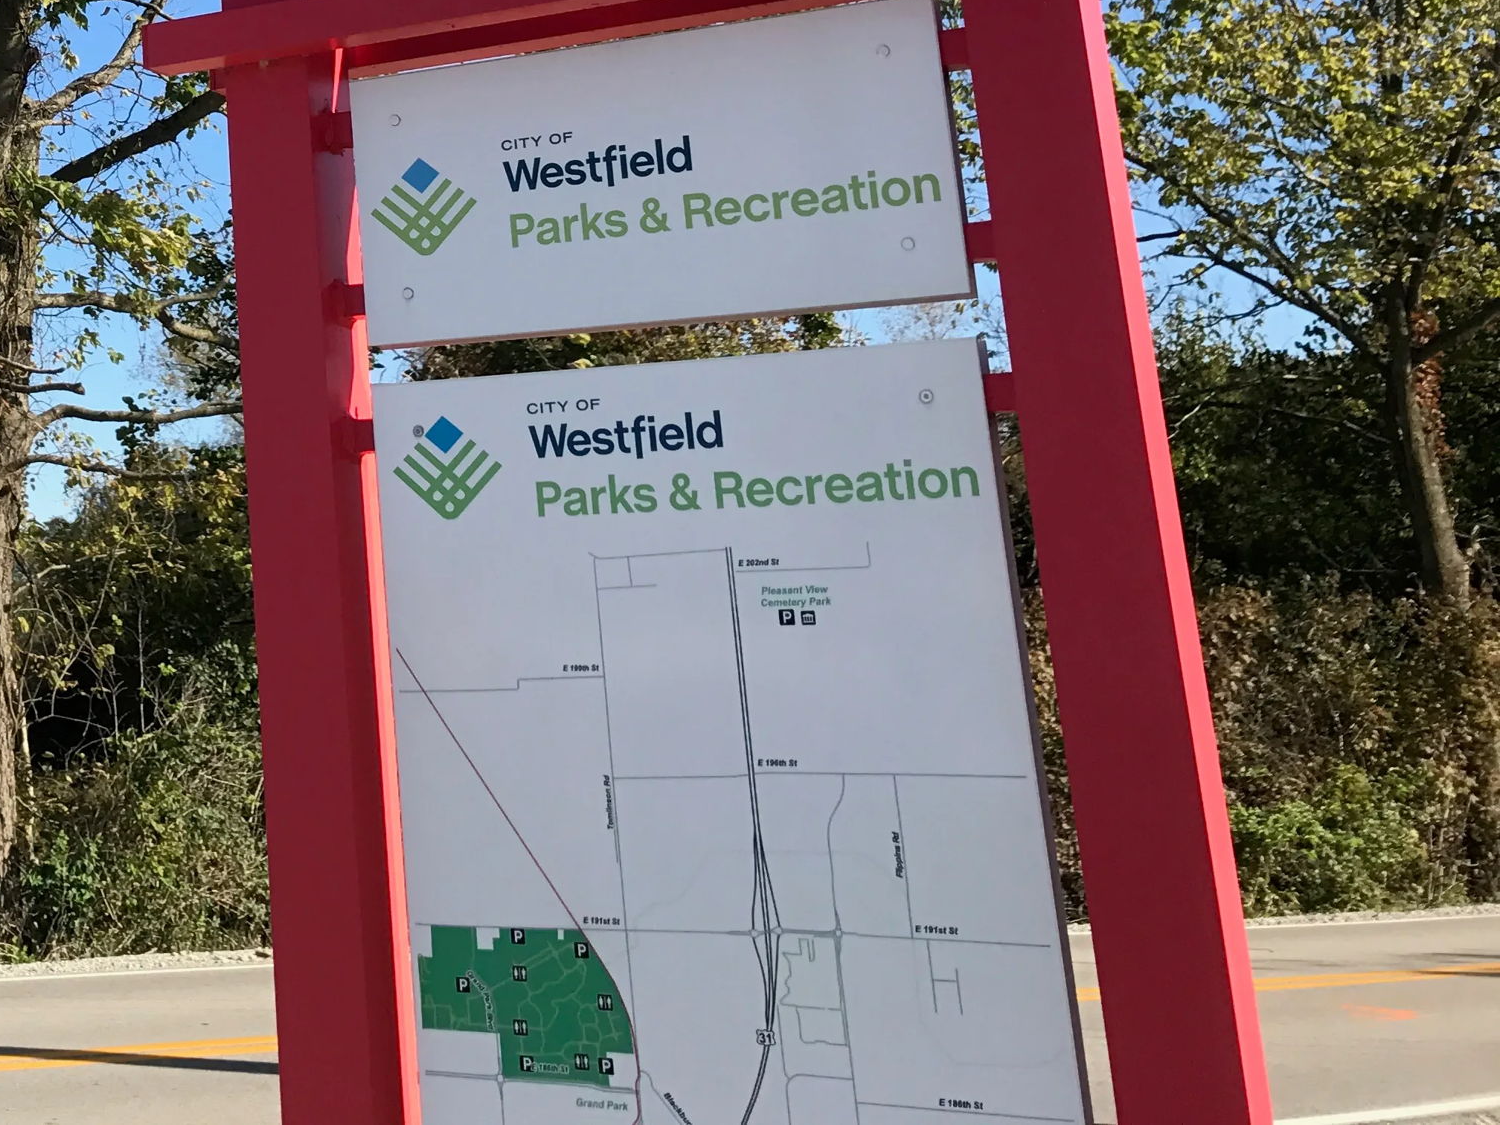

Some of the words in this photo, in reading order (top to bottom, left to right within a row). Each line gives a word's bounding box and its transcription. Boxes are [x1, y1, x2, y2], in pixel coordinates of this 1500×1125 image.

[500, 136, 542, 151] CITY
[549, 132, 573, 145] OF
[502, 135, 693, 192] Westfield
[509, 202, 629, 248] Parks
[639, 197, 671, 234] &
[682, 171, 942, 230] Recreation
[526, 401, 568, 415] CITY
[575, 398, 601, 411] OF
[528, 410, 724, 459] Westfield
[535, 474, 658, 517] Parks
[669, 472, 702, 511] &
[713, 459, 981, 509] Recreation
[738, 559, 744, 567] E
[746, 558, 769, 567] 202nd
[770, 558, 780, 566] St
[761, 586, 803, 596] Pleasant
[804, 585, 829, 594] View
[760, 598, 807, 609] Cemetery
[808, 597, 831, 606] Park
[562, 664, 569, 672] E
[591, 663, 600, 672] St
[757, 758, 764, 767] E
[788, 758, 798, 767] St
[602, 774, 611, 786] Rd
[582, 916, 589, 924] E
[611, 917, 621, 925] St
[915, 924, 922, 933] E
[948, 926, 959, 935] St
[759, 1032, 772, 1044] 31
[575, 1097, 605, 1110] Grand
[606, 1100, 628, 1111] Park
[938, 1098, 946, 1107] E
[973, 1100, 984, 1110] St
